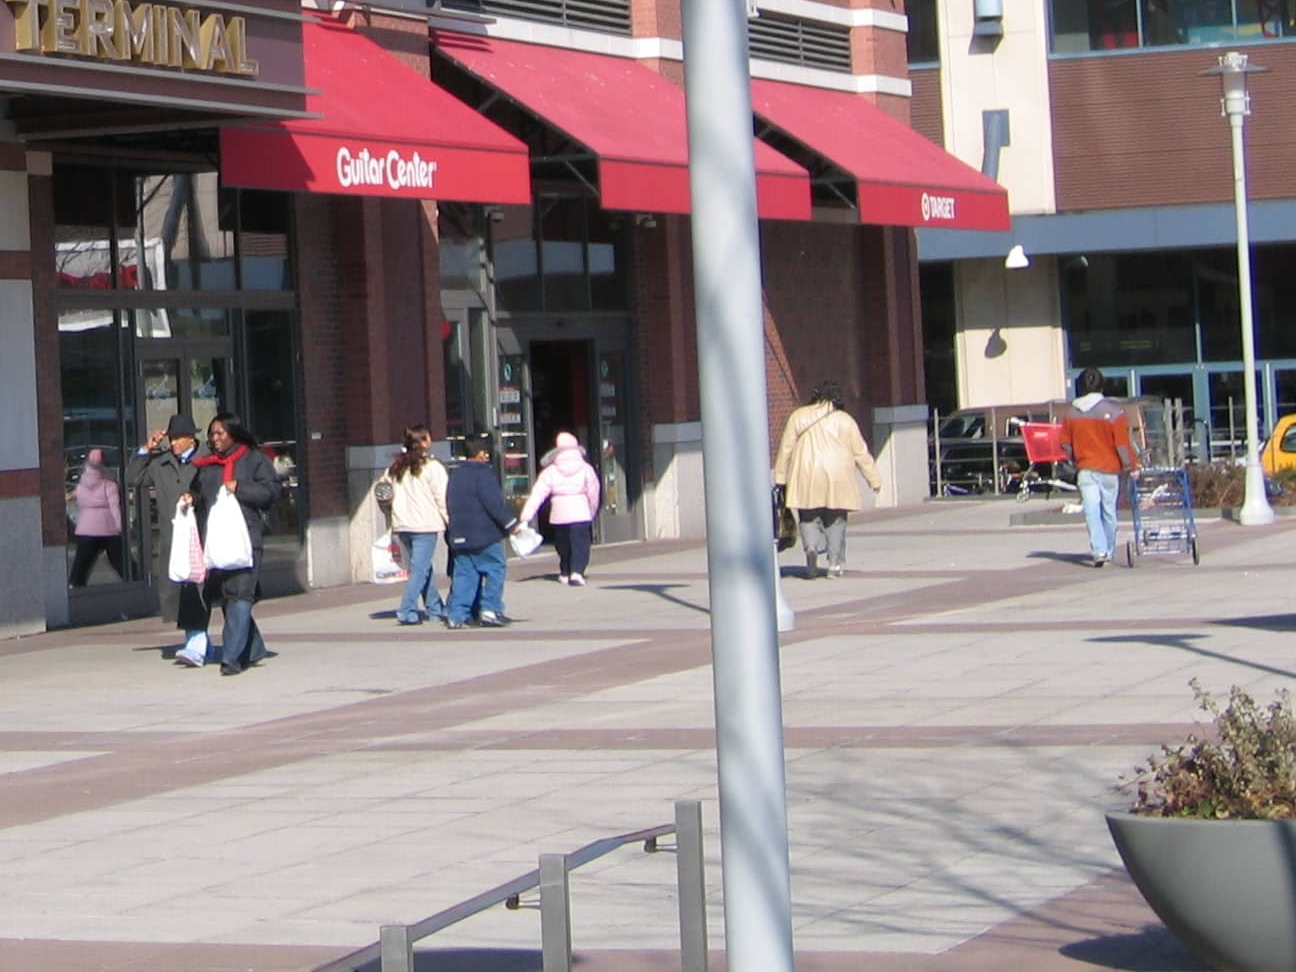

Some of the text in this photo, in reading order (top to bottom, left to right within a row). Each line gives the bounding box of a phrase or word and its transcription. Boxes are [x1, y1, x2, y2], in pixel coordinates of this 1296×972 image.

[336, 146, 438, 190] Guitar Center
[929, 196, 955, 220] TARGET
